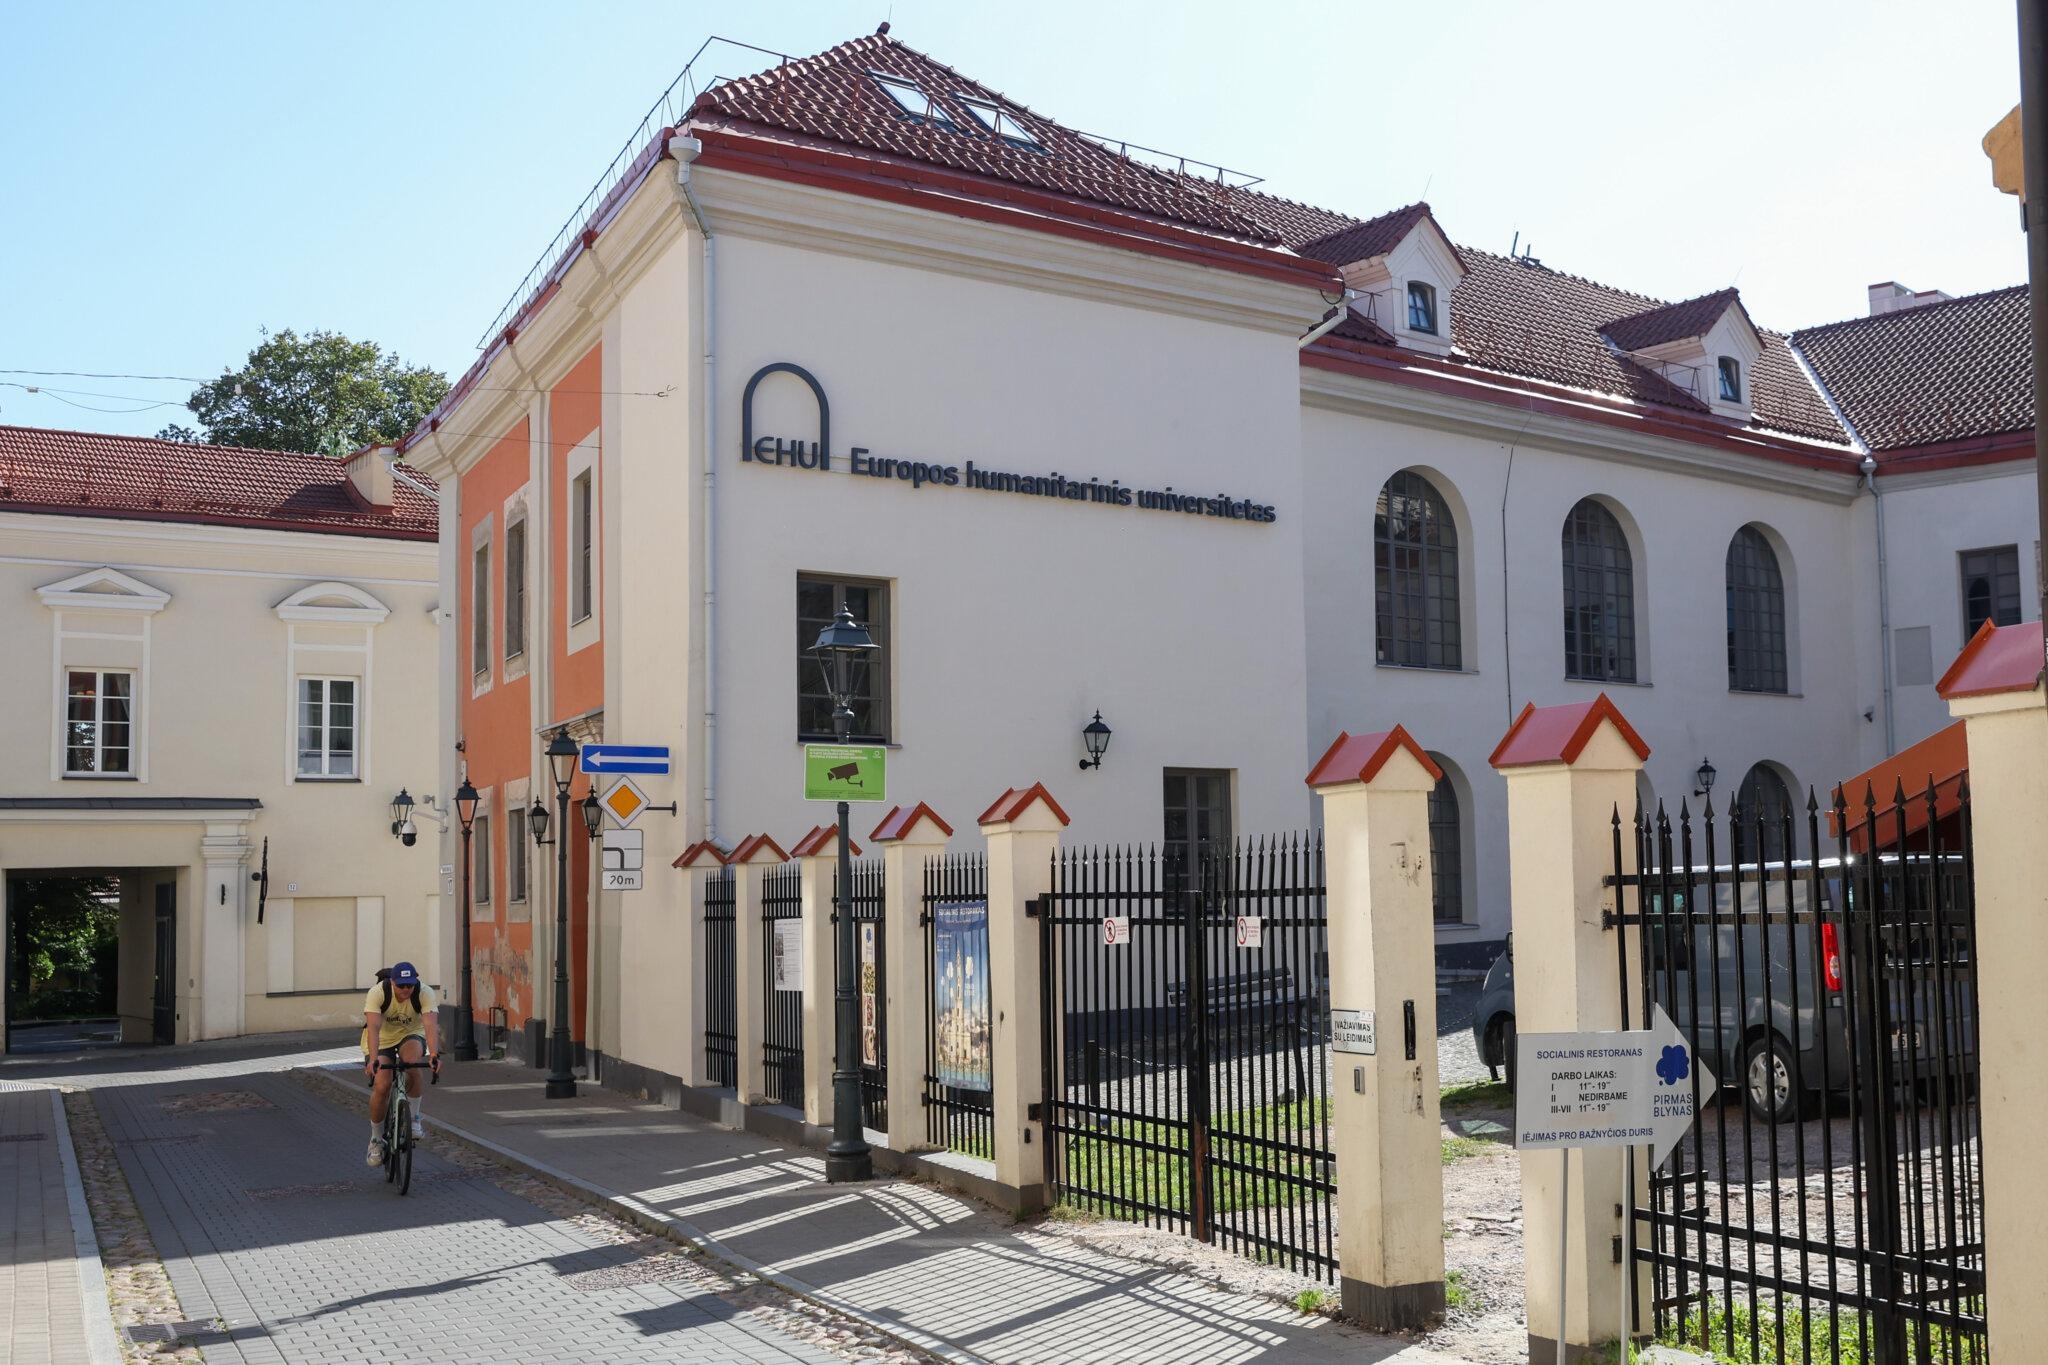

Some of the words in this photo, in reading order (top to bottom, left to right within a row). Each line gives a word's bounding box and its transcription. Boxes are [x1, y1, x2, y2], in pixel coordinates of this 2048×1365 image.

[754, 436, 819, 470] EHU
[850, 446, 959, 489] Europos
[966, 460, 1133, 507] humanitarinis
[1137, 486, 1277, 524] universitetas
[1334, 1020, 1371, 1031] ĮVAŽIAVIMAS
[1333, 1032, 1342, 1041] SU
[1343, 1033, 1373, 1044] LEIDIMAIS
[1536, 1050, 1585, 1059] SOCIALINIS
[1586, 1048, 1643, 1058] RESTORANAS
[1551, 1072, 1582, 1080] DARBO
[1584, 1070, 1617, 1079] LAIKAS:
[1551, 1094, 1556, 1102] II
[1578, 1092, 1628, 1101] NEDIRBAME
[1653, 1093, 1693, 1105] PIRMAS
[1550, 1105, 1571, 1113] III-VII
[1653, 1105, 1693, 1117] BLYNAS
[1522, 1131, 1557, 1143] ĮĖJIMAS
[1559, 1131, 1577, 1140] PRO
[1579, 1129, 1627, 1139] BAŽNYČIOS
[1628, 1127, 1654, 1137] DURIS
